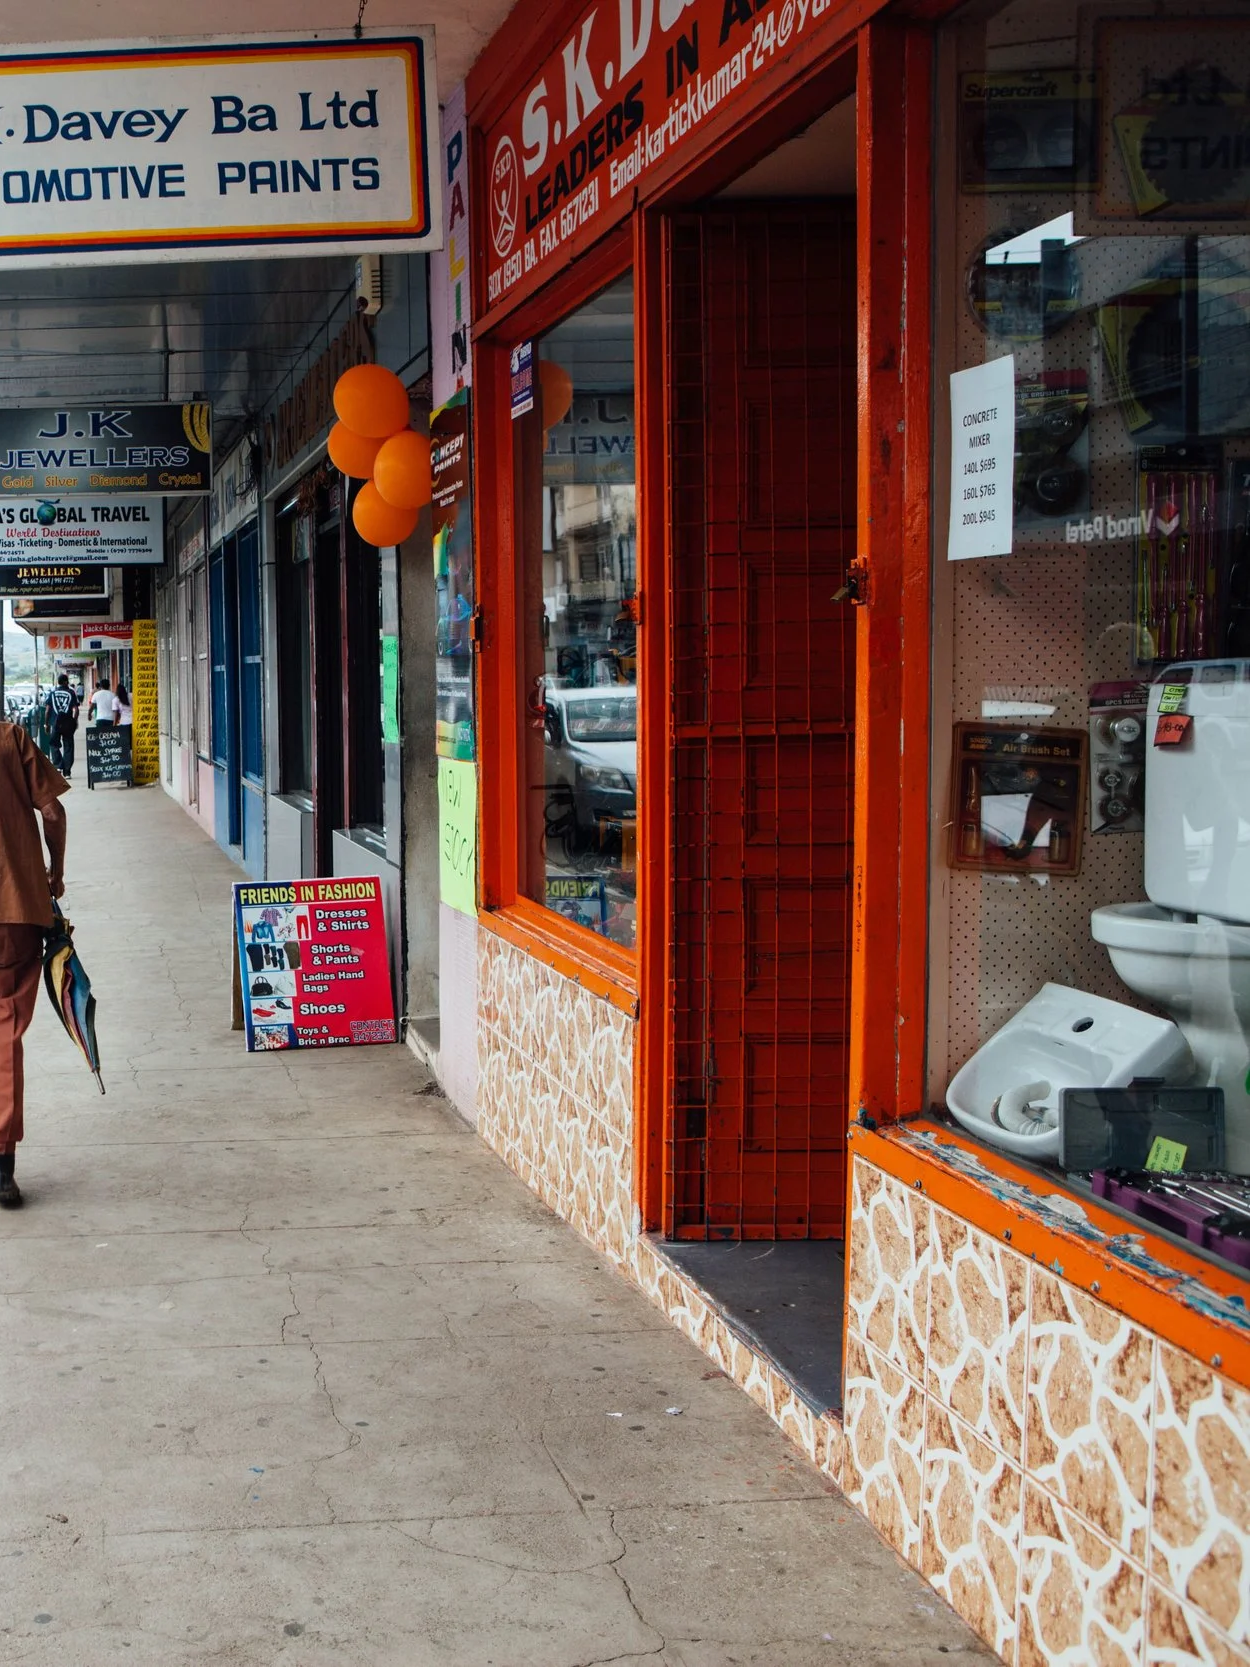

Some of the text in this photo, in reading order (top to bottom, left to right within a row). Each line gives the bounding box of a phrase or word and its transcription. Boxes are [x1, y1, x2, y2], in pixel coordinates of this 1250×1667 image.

[964, 81, 1059, 99] Supercraft
[211, 95, 277, 135] Ba
[299, 89, 379, 131] Ltd
[525, 79, 644, 234] LEADERS
[666, 20, 699, 98] IN
[218, 157, 380, 196] PAINTS
[488, 266, 502, 303] BOX
[504, 249, 522, 290] 1950
[560, 176, 599, 242] 6671231
[36, 411, 133, 439] J.K
[963, 407, 998, 428] CONCRETE
[968, 433, 991, 449] MIXER
[434, 451, 462, 475] PAINTS
[964, 457, 996, 475] 140L $695
[1, 472, 202, 489] Gold Silver Diamond Crystal
[963, 483, 996, 500] 160L $765
[91, 506, 150, 523] TRAVEL
[962, 509, 996, 526] 200L $945
[6, 527, 101, 538] World Destinations
[58, 537, 91, 547] Domestic
[93, 538, 98, 546] &
[100, 536, 148, 547] International
[84, 624, 103, 633] Jacks
[1003, 743, 1070, 757] Air Brush Set
[239, 882, 376, 905] FRIENDS IN FASHION
[315, 908, 367, 920] Dresses
[317, 919, 370, 932] & Shirts
[311, 943, 351, 954] Shorts
[312, 953, 360, 966] & Pants
[302, 970, 364, 982] Ladies Hand
[303, 983, 329, 994] Bags
[300, 1003, 346, 1016] Shoes
[297, 1025, 329, 1036] Toys &
[298, 1036, 317, 1046] Bric
[328, 1035, 350, 1045] Brac
